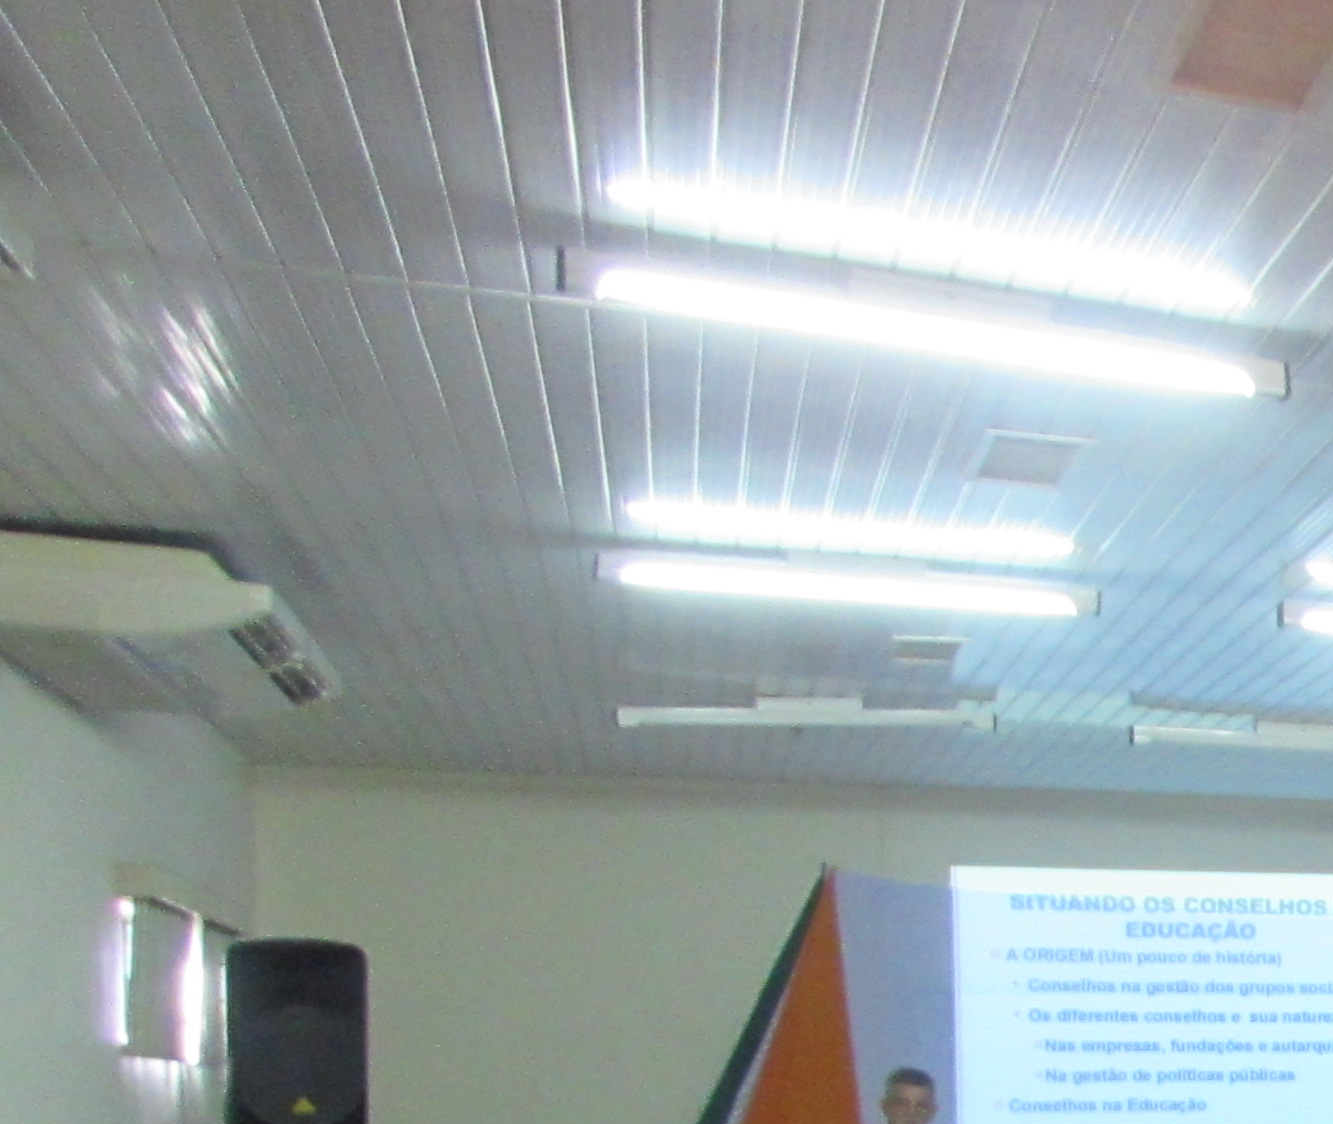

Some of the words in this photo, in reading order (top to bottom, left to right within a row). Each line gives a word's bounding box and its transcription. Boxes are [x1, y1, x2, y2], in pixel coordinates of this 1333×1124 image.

[1009, 893, 1138, 914] SITUANDO
[1143, 896, 1177, 914] OS
[1183, 896, 1329, 916] CONSELHOS
[1124, 919, 1257, 943] EDUCAÇÃO
[1006, 948, 1021, 962] A
[1022, 947, 1096, 963] ORIGEM
[1098, 949, 1134, 965] (Um
[1136, 952, 1190, 966] pouco
[1191, 950, 1213, 965] de
[1215, 950, 1282, 968] história)
[1027, 978, 1117, 994] Conselhos
[1119, 981, 1142, 995] na
[1145, 979, 1201, 997] gestão
[1204, 979, 1235, 995] dos
[1238, 982, 1297, 998] grupos
[1027, 1008, 1053, 1023] Os
[1055, 1008, 1140, 1024] diferentes
[1143, 1008, 1228, 1024] conselhos
[1230, 1012, 1243, 1024] e
[1248, 1012, 1280, 1024] sua
[1044, 1038, 1078, 1053] Nas
[1080, 1040, 1166, 1056] empresas,
[1170, 1038, 1255, 1056] fundações
[1257, 1041, 1269, 1053] e
[1044, 1068, 1069, 1084] Na
[1071, 1068, 1129, 1086] gestão
[1132, 1068, 1154, 1083] de
[1155, 1067, 1226, 1086] políticas
[1228, 1068, 1297, 1086] públicas
[1008, 1098, 1099, 1113] Conselhos
[1101, 1100, 1124, 1113] na
[1126, 1097, 1208, 1114] Educação
